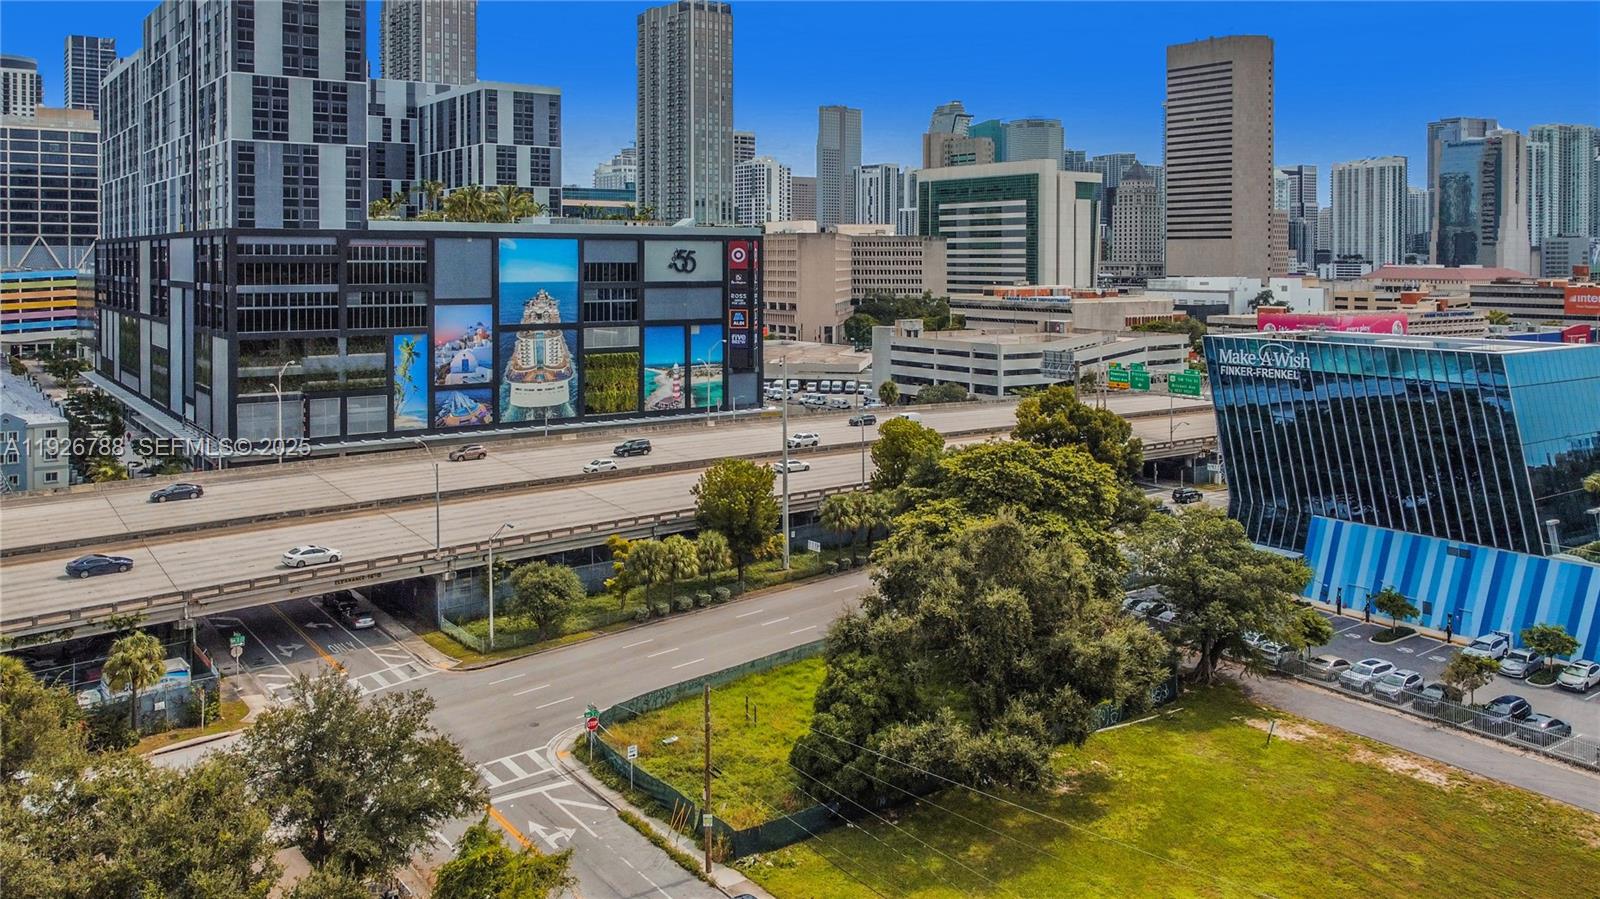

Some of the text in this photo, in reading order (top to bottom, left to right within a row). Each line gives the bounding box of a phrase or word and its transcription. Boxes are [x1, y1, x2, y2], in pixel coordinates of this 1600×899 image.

[1219, 348, 1310, 369] Make-A-Wish
[1220, 366, 1300, 380] FINKER-FRENKEL
[328, 641, 357, 654] ONLY
